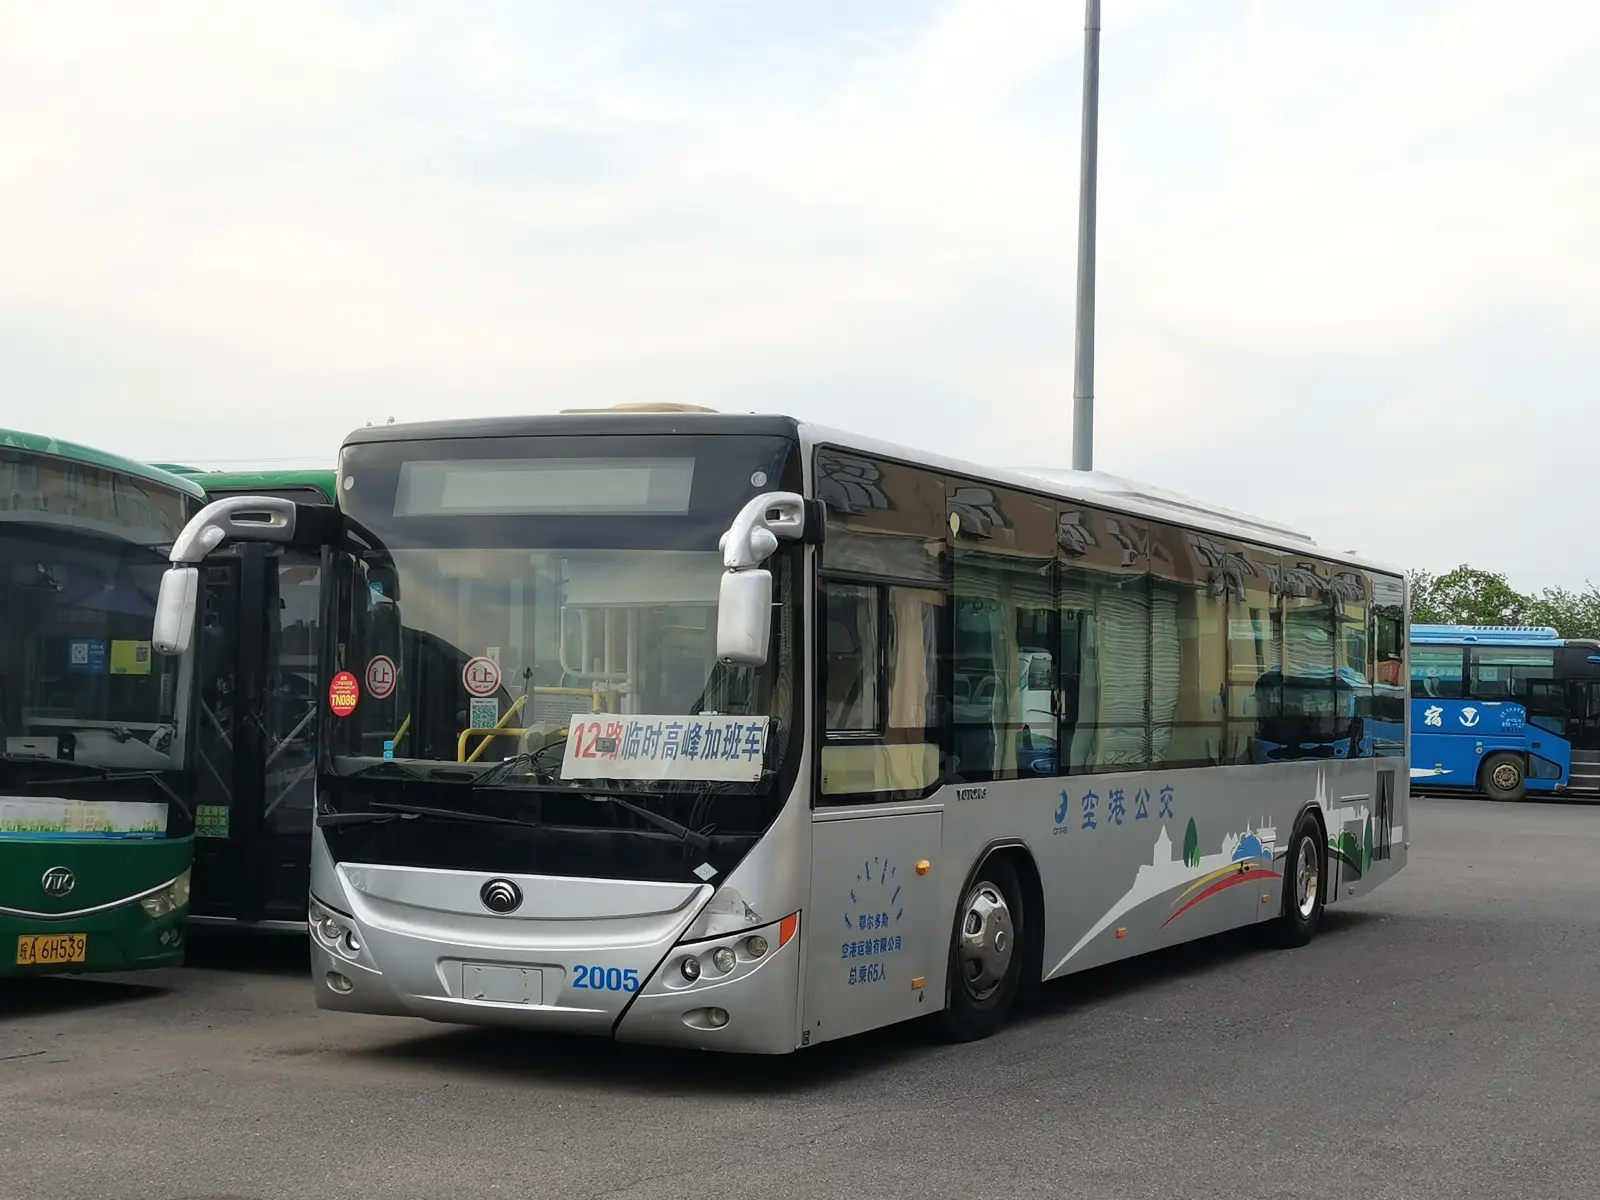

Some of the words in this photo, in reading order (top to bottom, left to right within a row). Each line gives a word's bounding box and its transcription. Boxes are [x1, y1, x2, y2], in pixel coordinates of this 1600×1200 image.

[573, 720, 763, 761] 12路临时高峰加班车
[1081, 784, 1174, 830] 空港公交
[859, 911, 889, 930] 鄂尔多斯
[841, 935, 903, 959] 空港运输有限公司
[572, 964, 639, 993] 2005
[848, 963, 887, 986] 总乘65人
